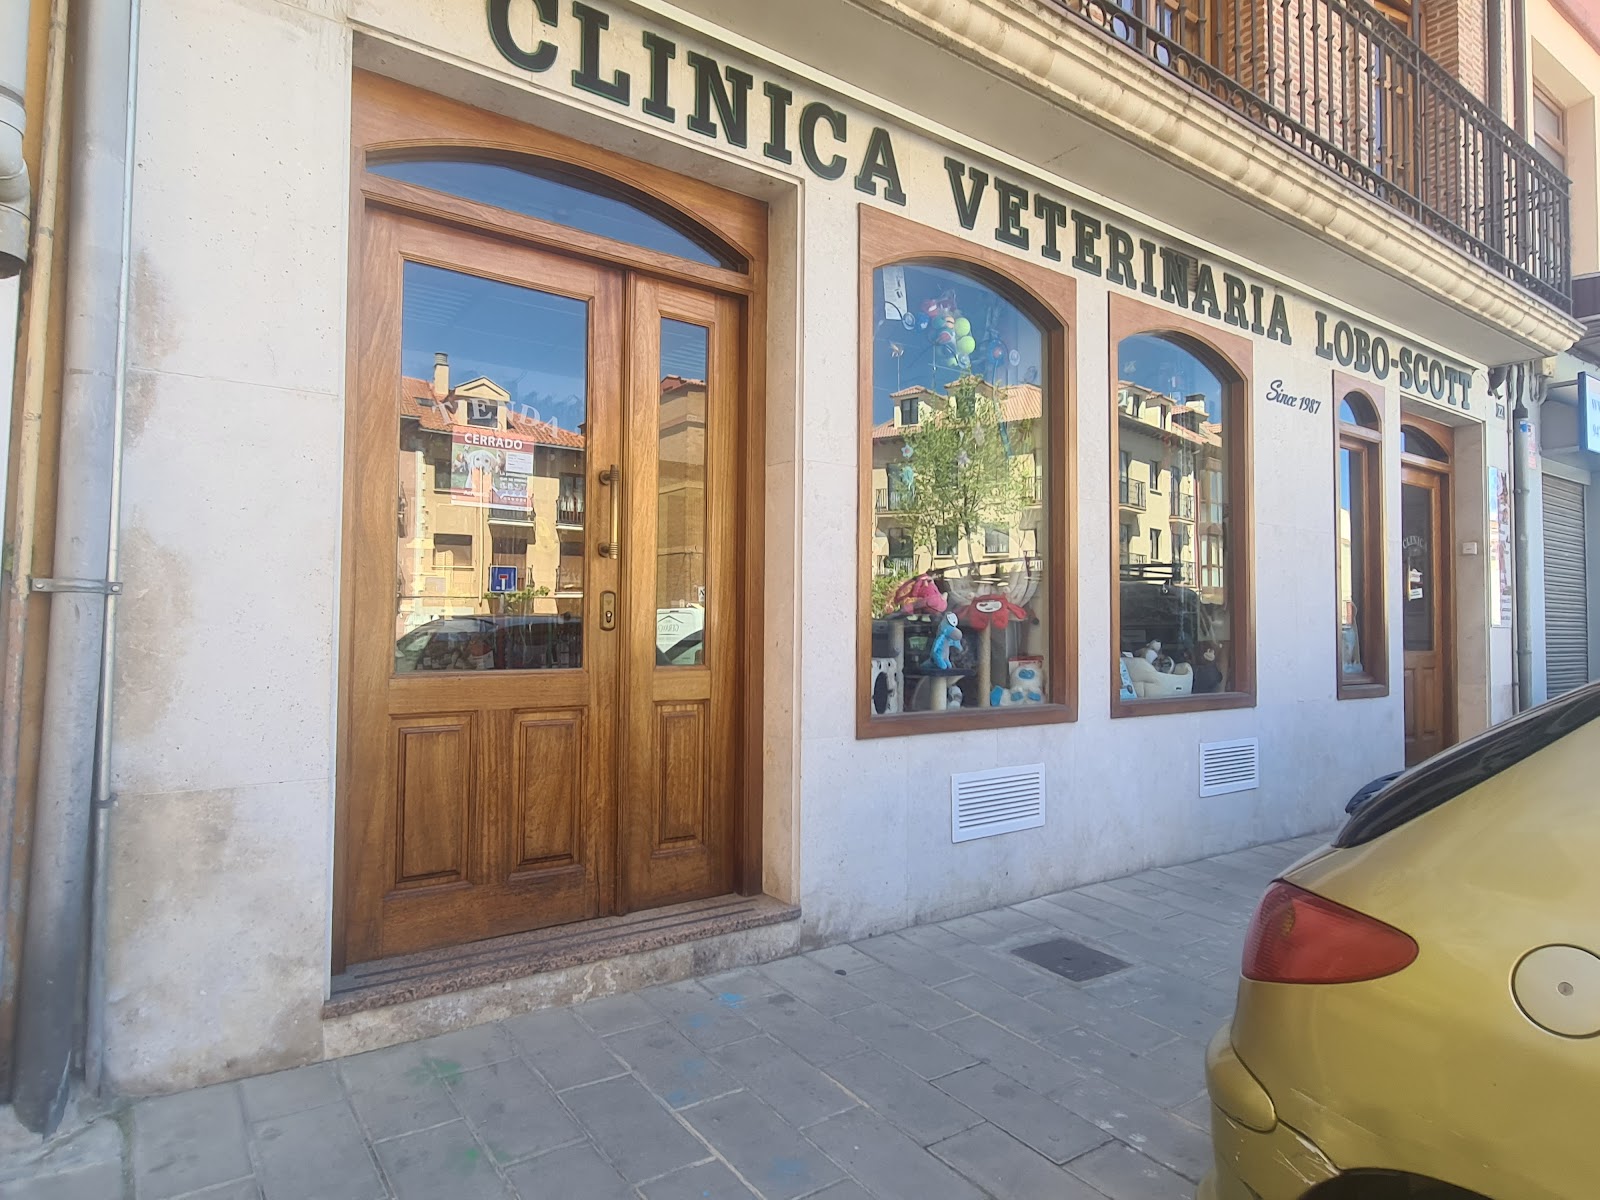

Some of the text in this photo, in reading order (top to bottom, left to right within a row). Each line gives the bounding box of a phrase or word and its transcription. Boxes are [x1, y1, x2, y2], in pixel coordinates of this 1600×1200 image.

[486, 0, 1472, 410] CLINICA VETERINARIA LOBO-SCOTT
[1265, 379, 1321, 414] Since 1987
[464, 433, 523, 450] CERRADO
